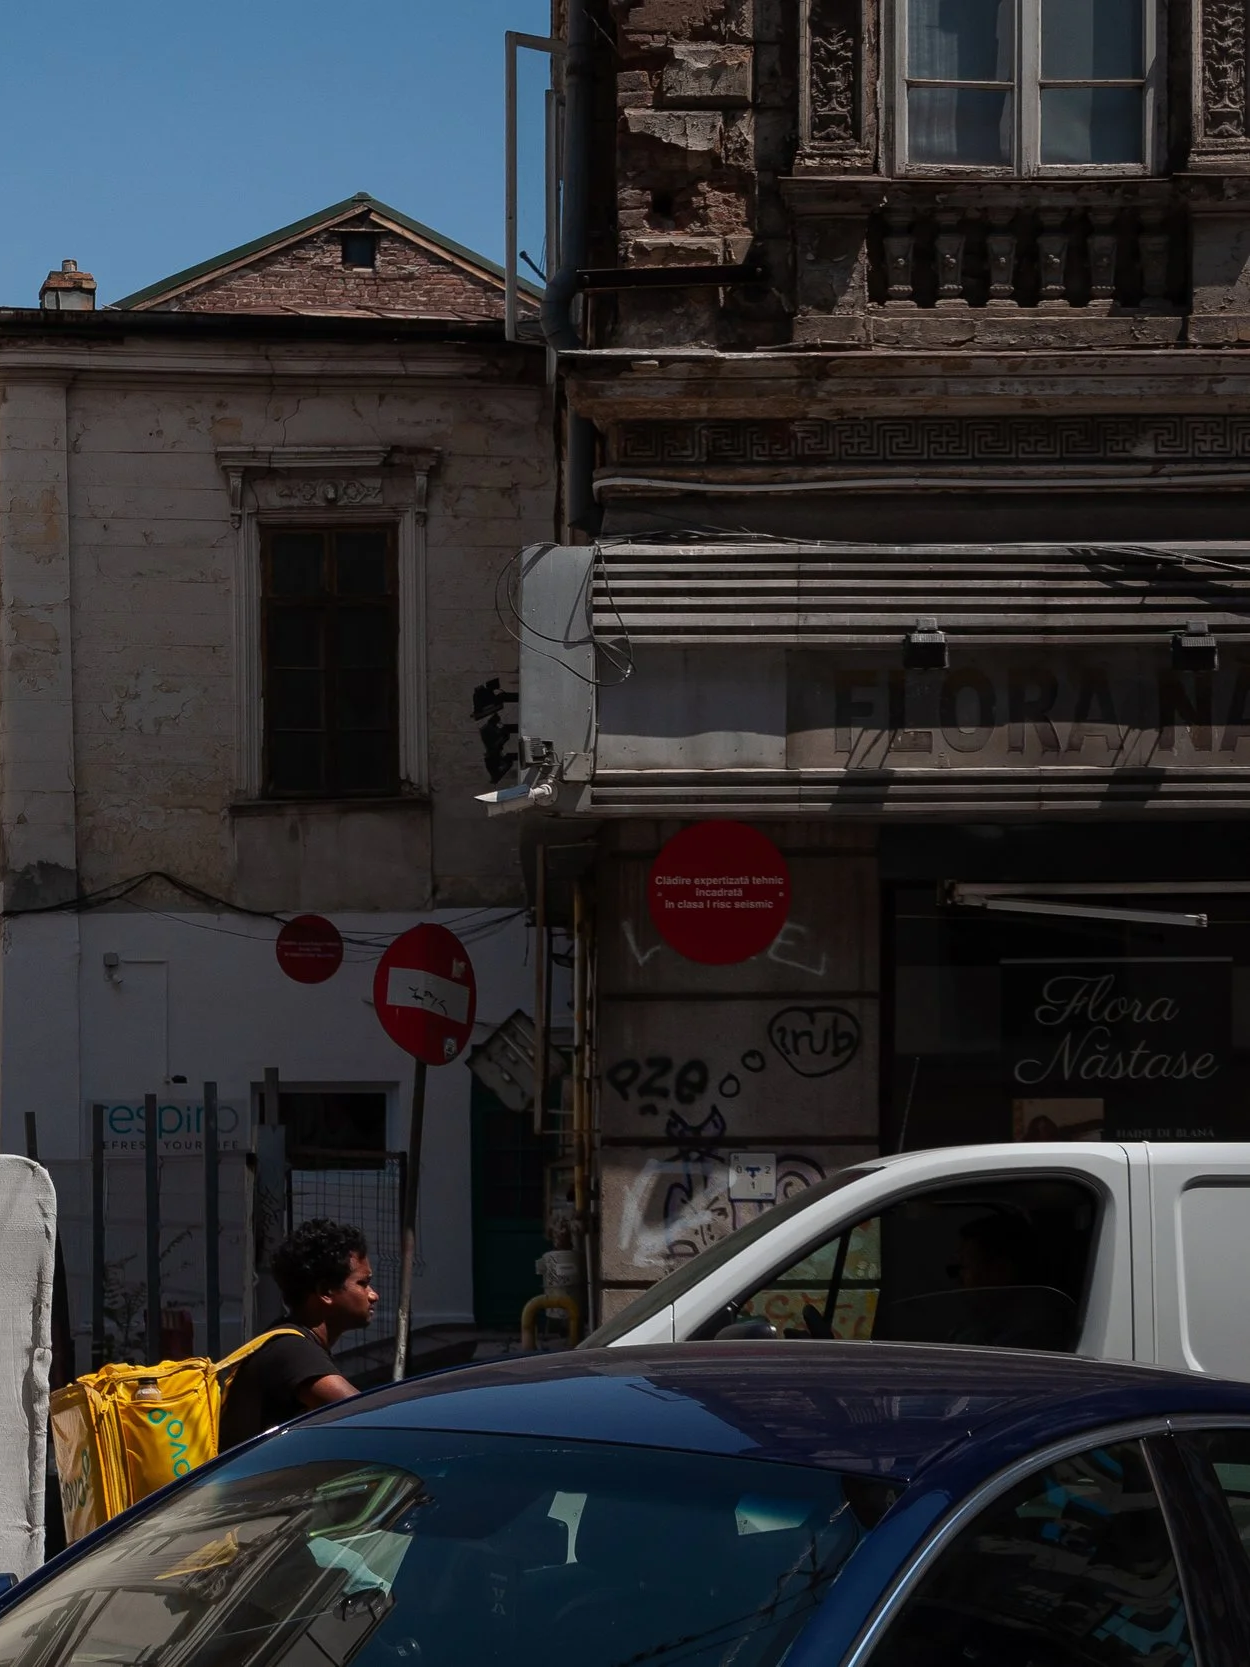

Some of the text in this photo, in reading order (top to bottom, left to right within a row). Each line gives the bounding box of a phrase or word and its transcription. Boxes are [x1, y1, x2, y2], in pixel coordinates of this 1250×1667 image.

[835, 667, 1125, 754] FLORA
[655, 875, 784, 888] Clădire expertizată tehnic
[696, 887, 743, 898] încadrată
[677, 899, 705, 909] clasa
[713, 899, 732, 909] risc
[734, 899, 774, 909] seismic
[1034, 973, 1181, 1026] Flora
[1013, 1025, 1220, 1085] Năstase
[103, 1105, 239, 1139] espiro
[163, 1140, 203, 1151] YOUR
